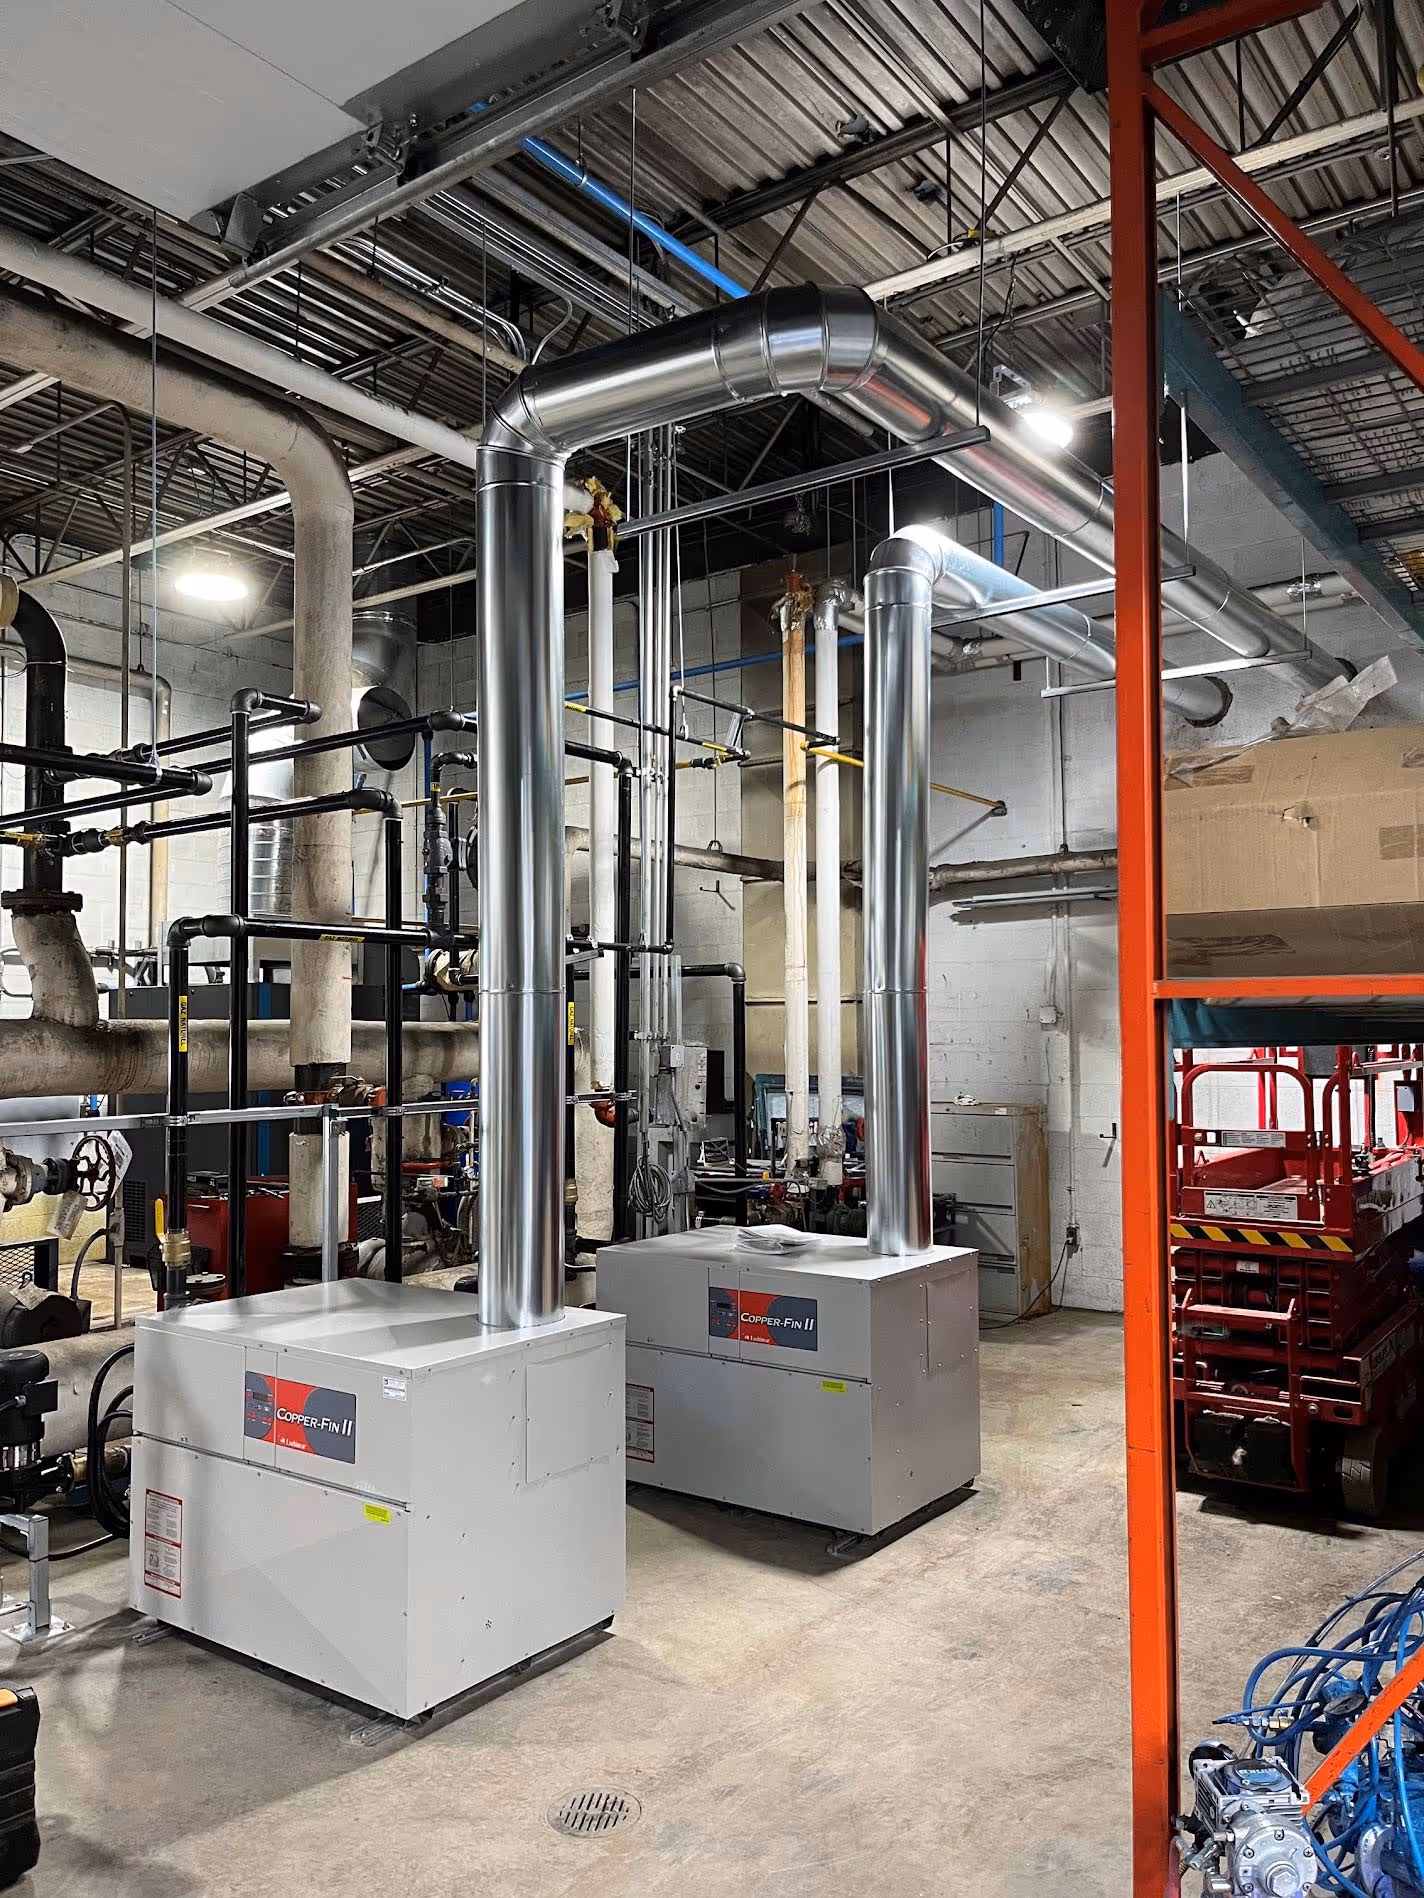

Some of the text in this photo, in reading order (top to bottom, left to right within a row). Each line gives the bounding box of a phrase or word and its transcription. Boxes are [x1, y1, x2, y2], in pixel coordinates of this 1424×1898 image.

[740, 1312, 802, 1330] COPPER-FIN
[804, 1317, 815, 1331] II
[276, 1407, 353, 1437] COPPER-FIN II
